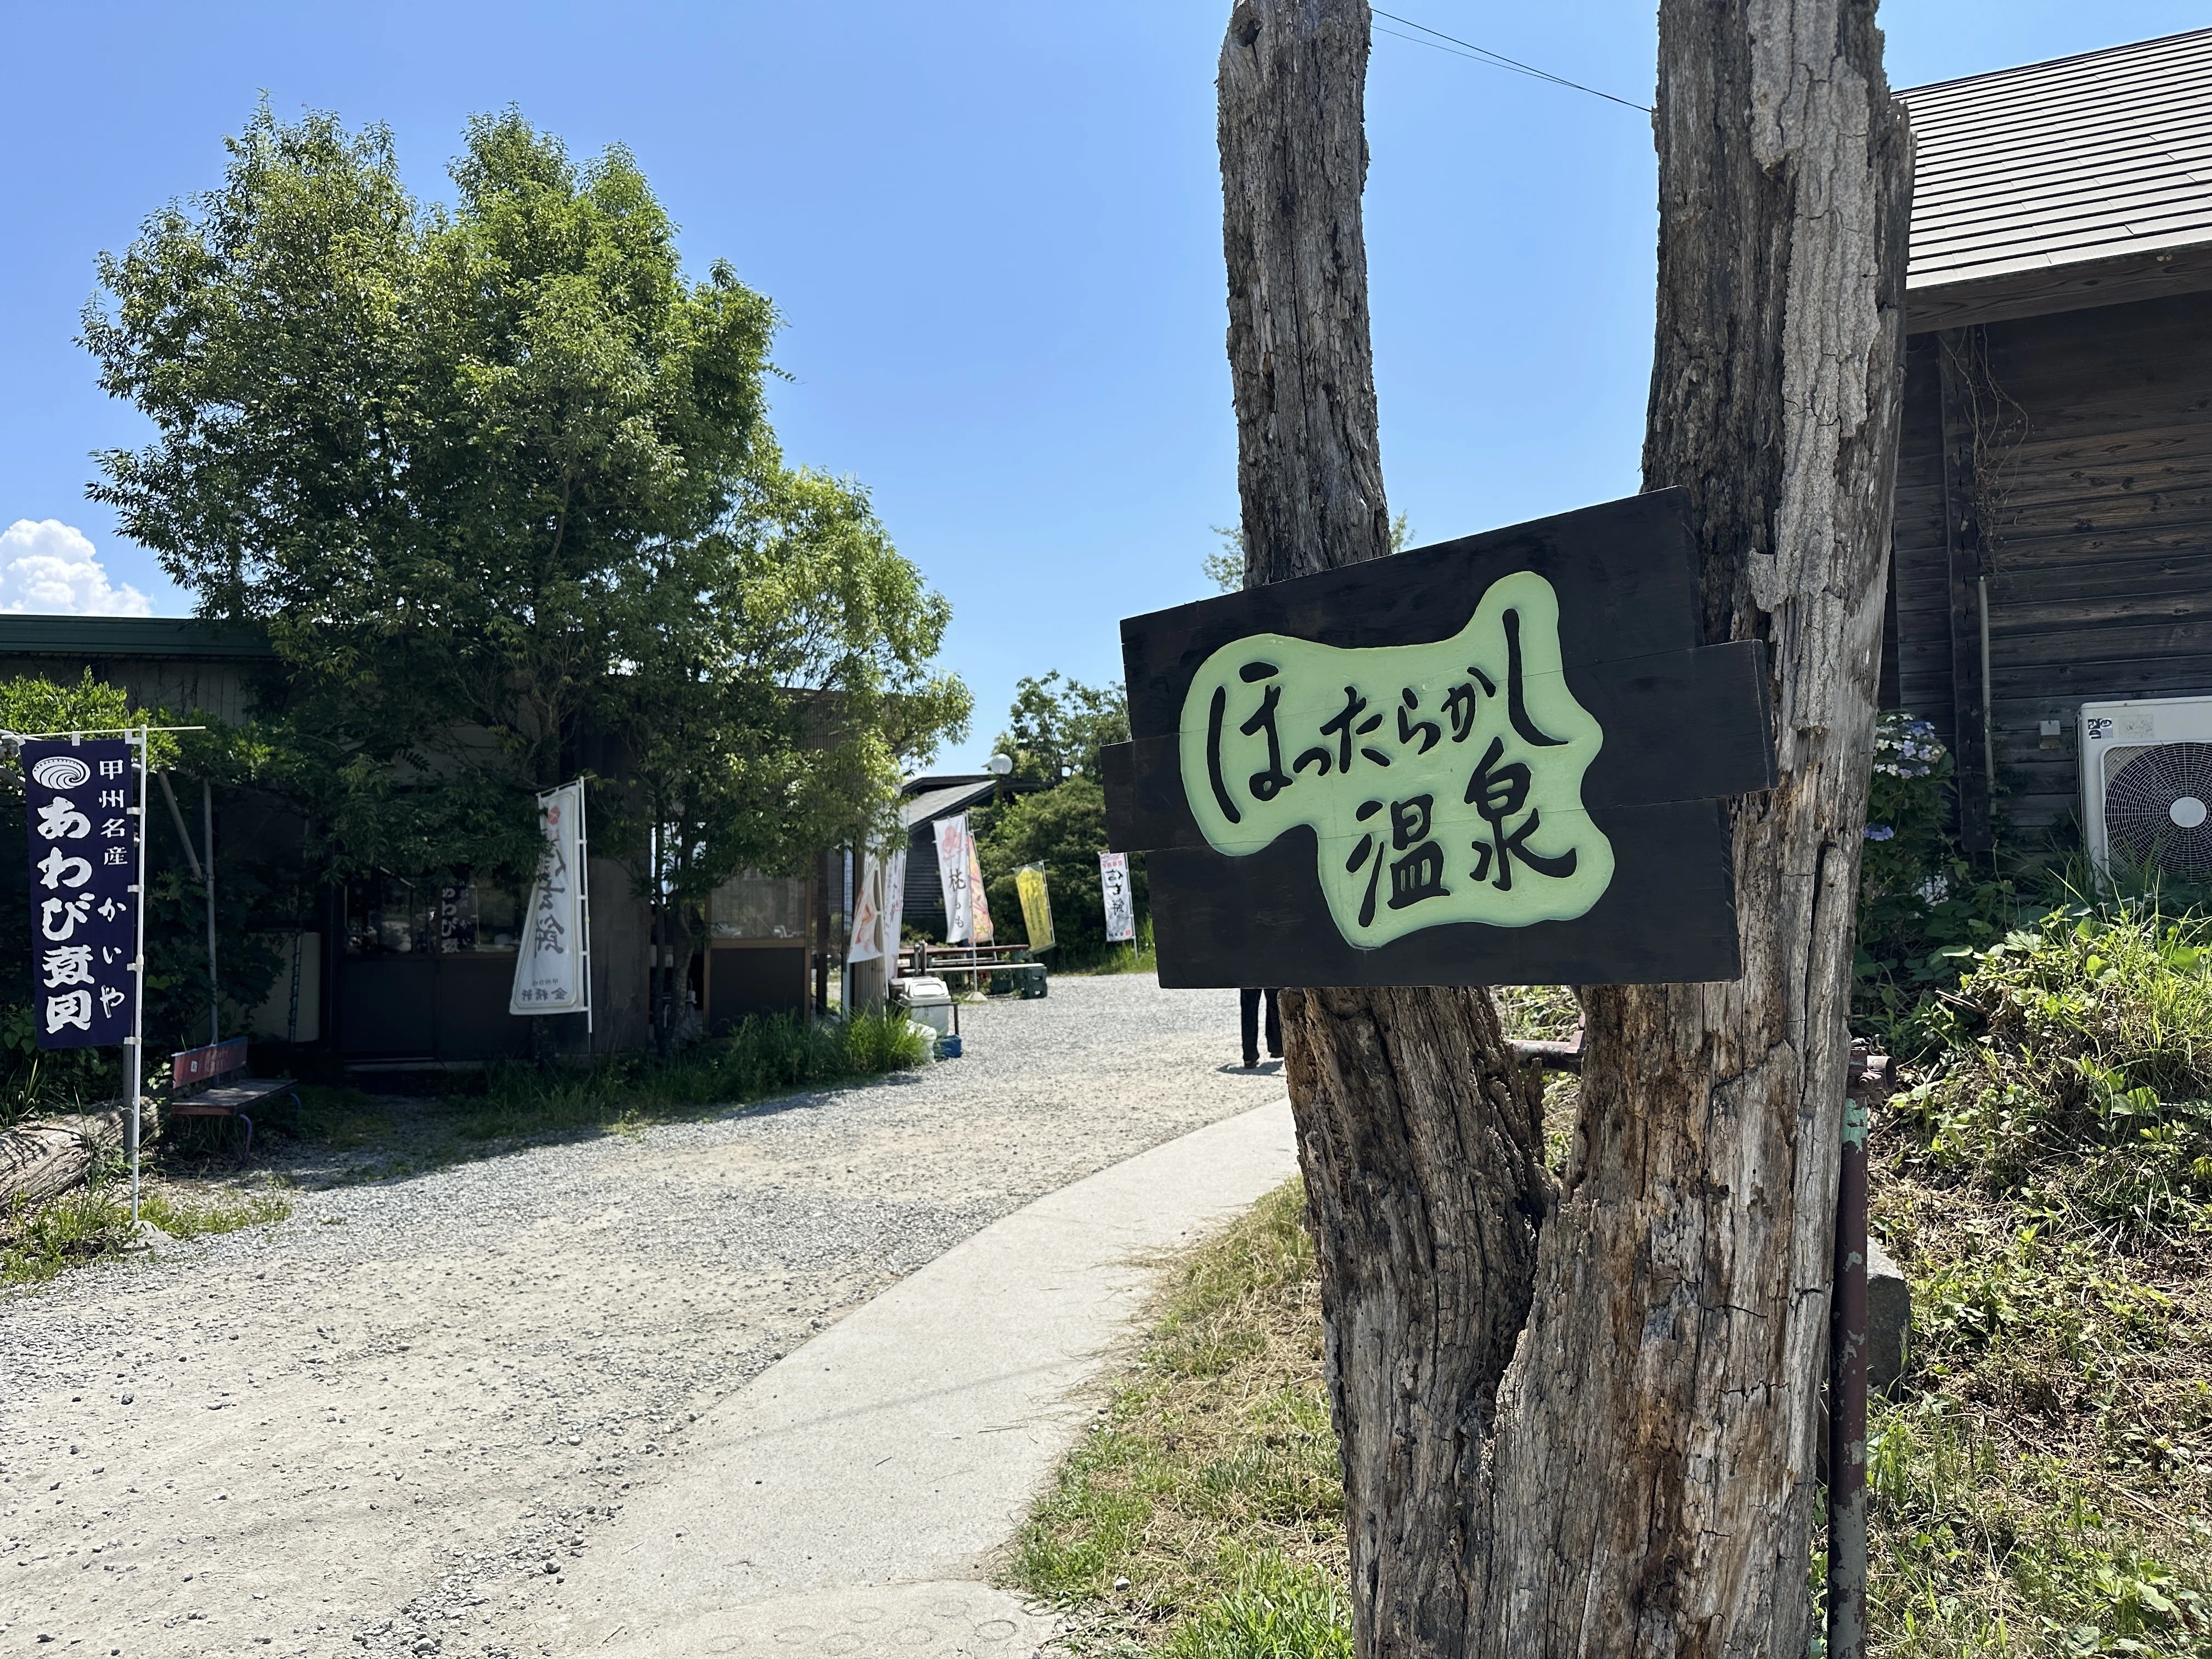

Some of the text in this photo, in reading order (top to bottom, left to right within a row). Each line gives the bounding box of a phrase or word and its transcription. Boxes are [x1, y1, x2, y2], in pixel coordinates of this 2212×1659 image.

[1208, 608, 1569, 825] ほったらかし
[37, 796, 95, 1034] あわび煮貝
[98, 759, 128, 1018] 甲州名産 かいや
[1346, 736, 1577, 928] 温泉
